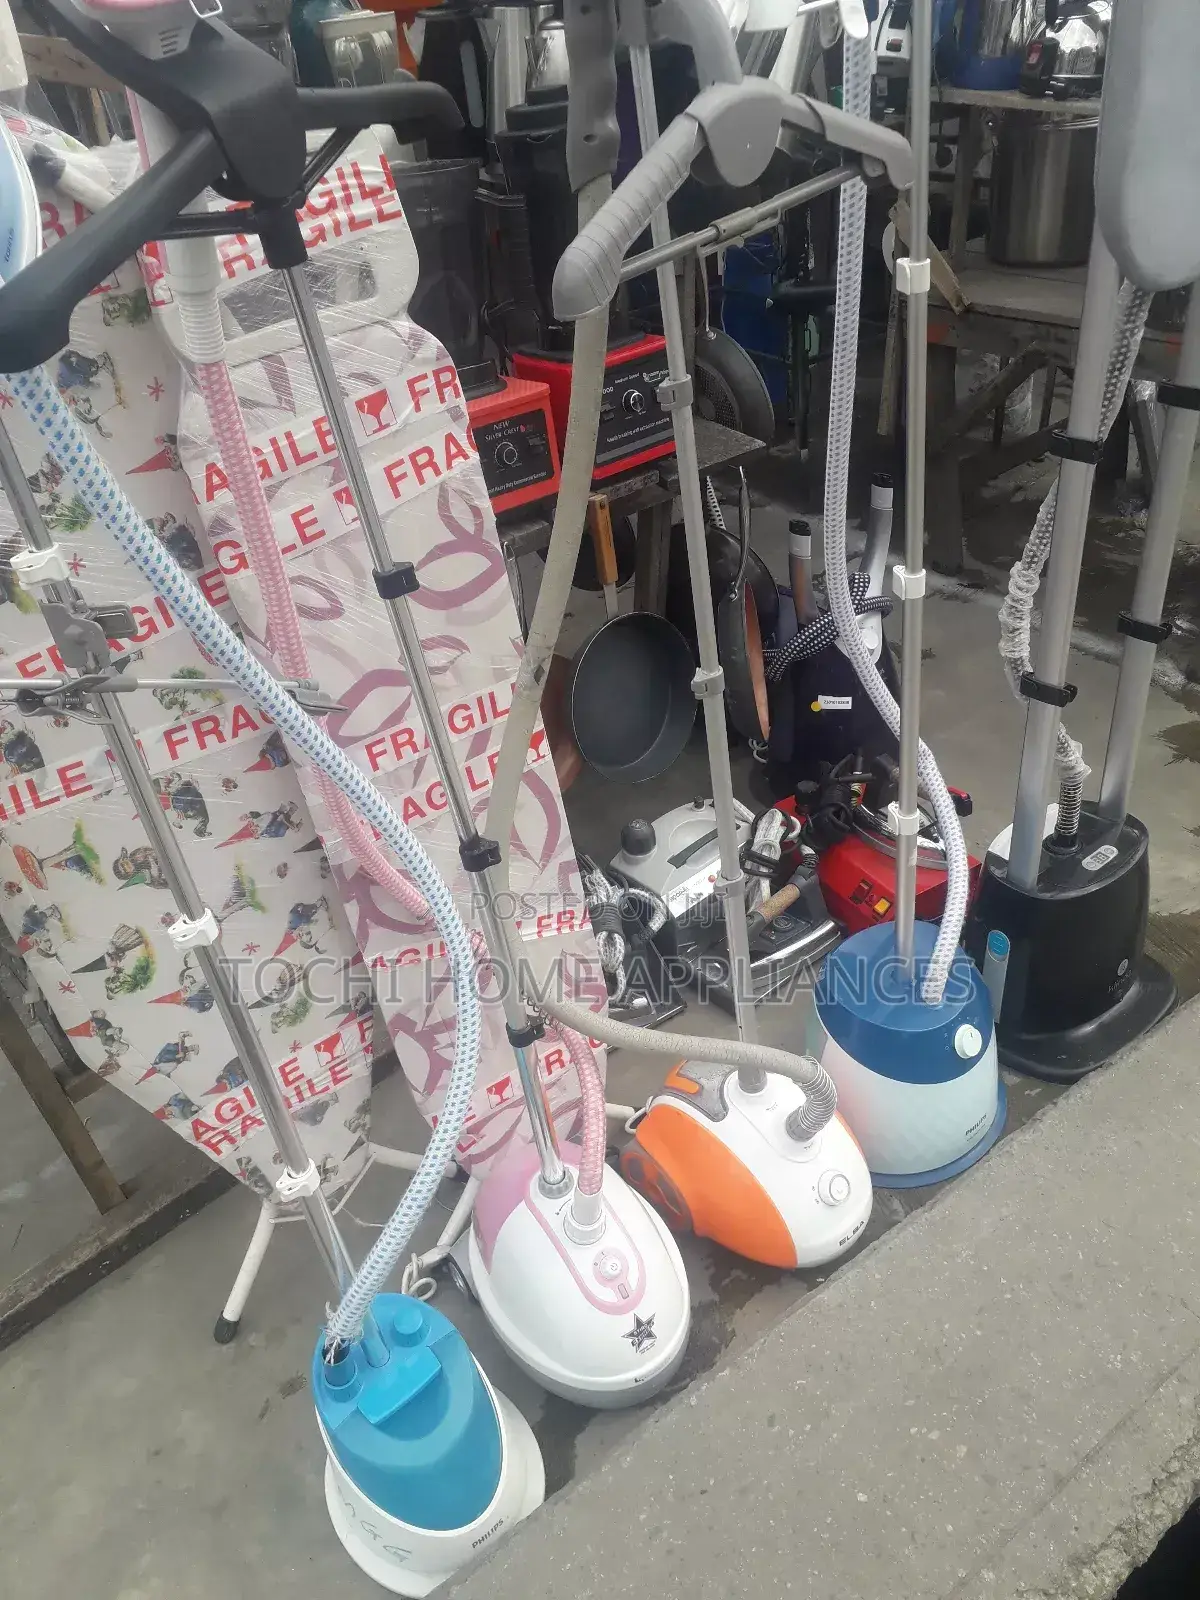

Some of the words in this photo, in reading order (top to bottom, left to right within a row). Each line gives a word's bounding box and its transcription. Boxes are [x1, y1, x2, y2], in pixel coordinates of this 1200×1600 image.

[493, 420, 510, 431] NEW
[0, 760, 93, 819] ILE
[471, 1517, 504, 1549] PHILIPS
